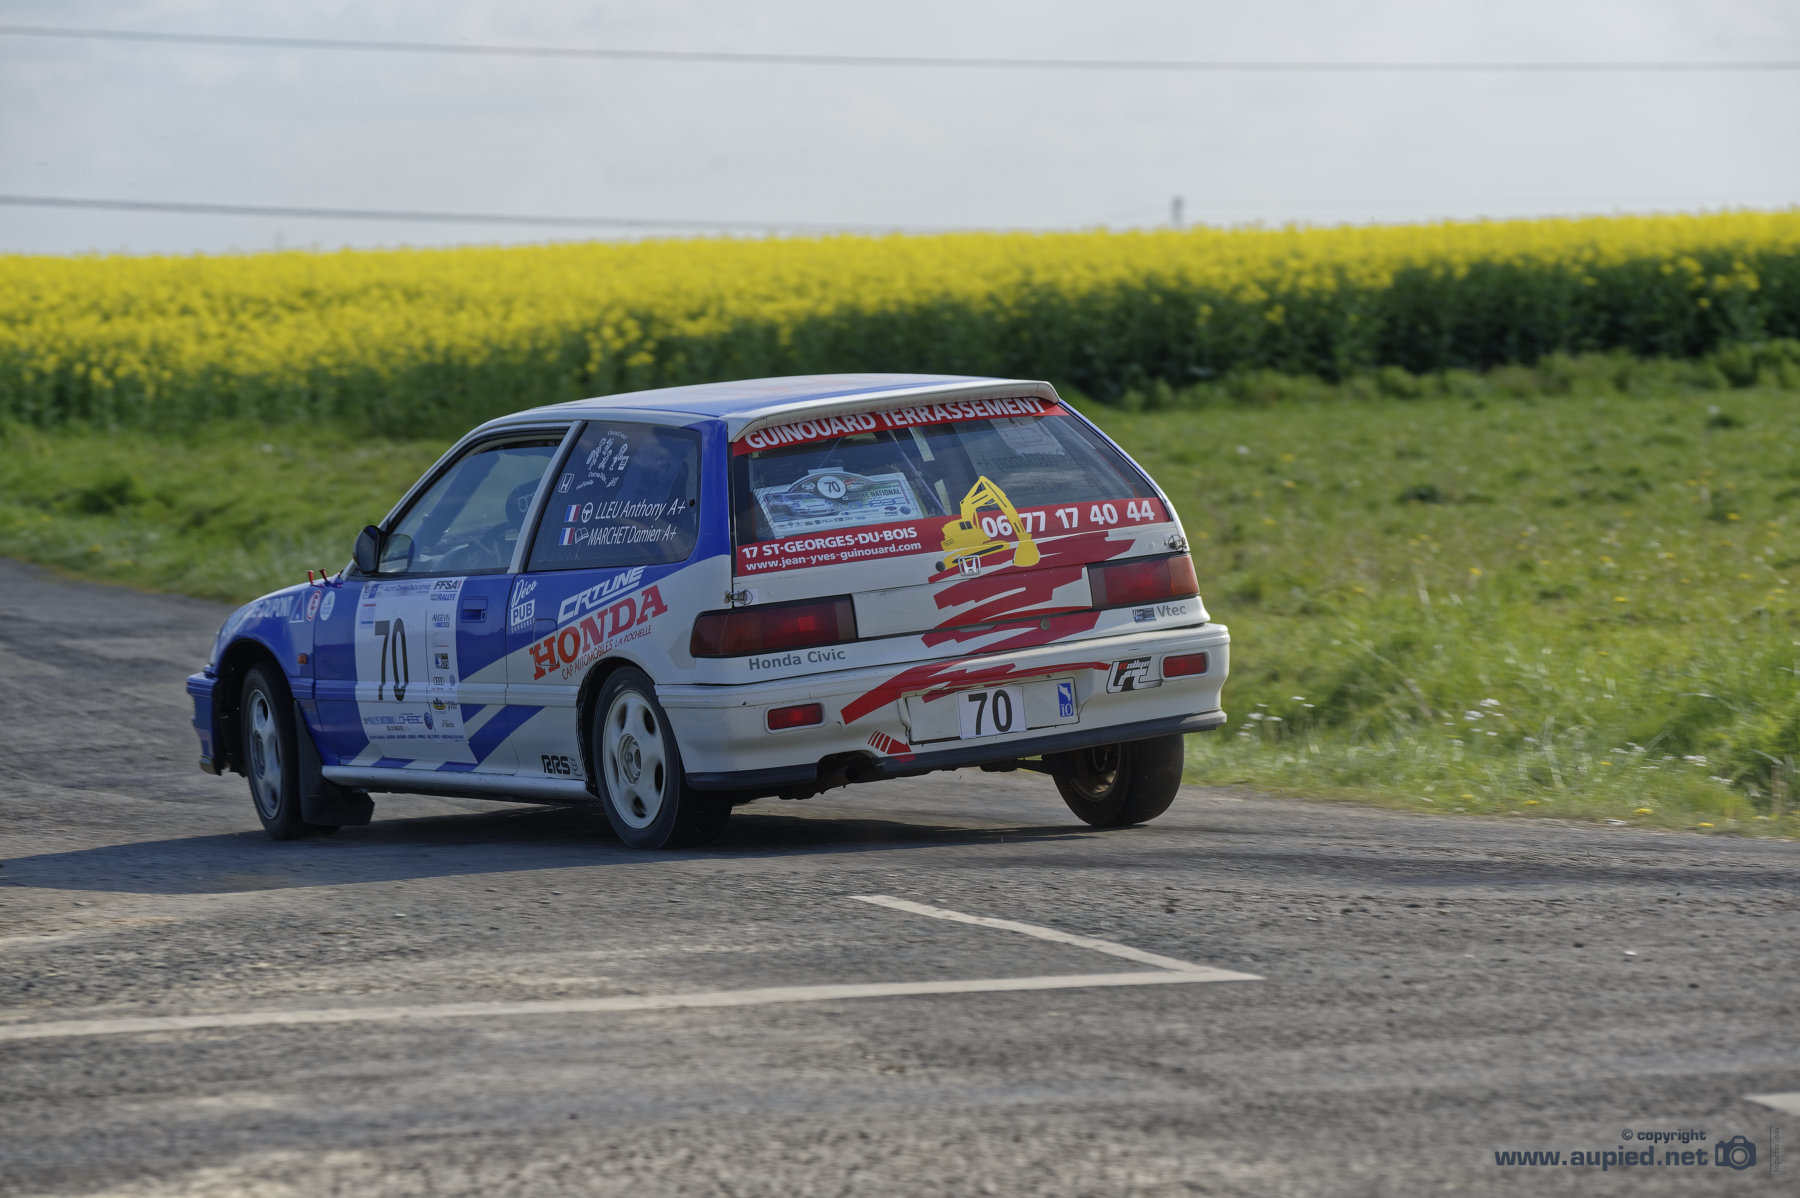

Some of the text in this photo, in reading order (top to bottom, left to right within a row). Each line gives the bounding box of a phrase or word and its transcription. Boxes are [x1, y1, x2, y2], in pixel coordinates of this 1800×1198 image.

[745, 397, 1048, 449] GUINOUARD TERRASSEMENT
[824, 481, 841, 494] 70
[870, 489, 902, 498] NATIONAL
[595, 498, 686, 521] LLEU Anthony A+
[981, 500, 1155, 538] 06 77 17 40 44
[587, 523, 677, 546] MARCHET Damien A+
[743, 547, 758, 559] 17
[745, 540, 922, 571] www.jean-yves-guinouard.com
[432, 580, 458, 591] FFSA
[512, 603, 534, 624] PUB
[1156, 604, 1187, 617] Vtec
[529, 584, 668, 681] HONDA
[374, 617, 409, 702] 70
[574, 638, 614, 674] AUTOMOBILES
[623, 625, 653, 643] ROCHELLE
[748, 648, 847, 671] Honda Civic
[967, 689, 1013, 736] 70
[541, 754, 571, 775] RRS
